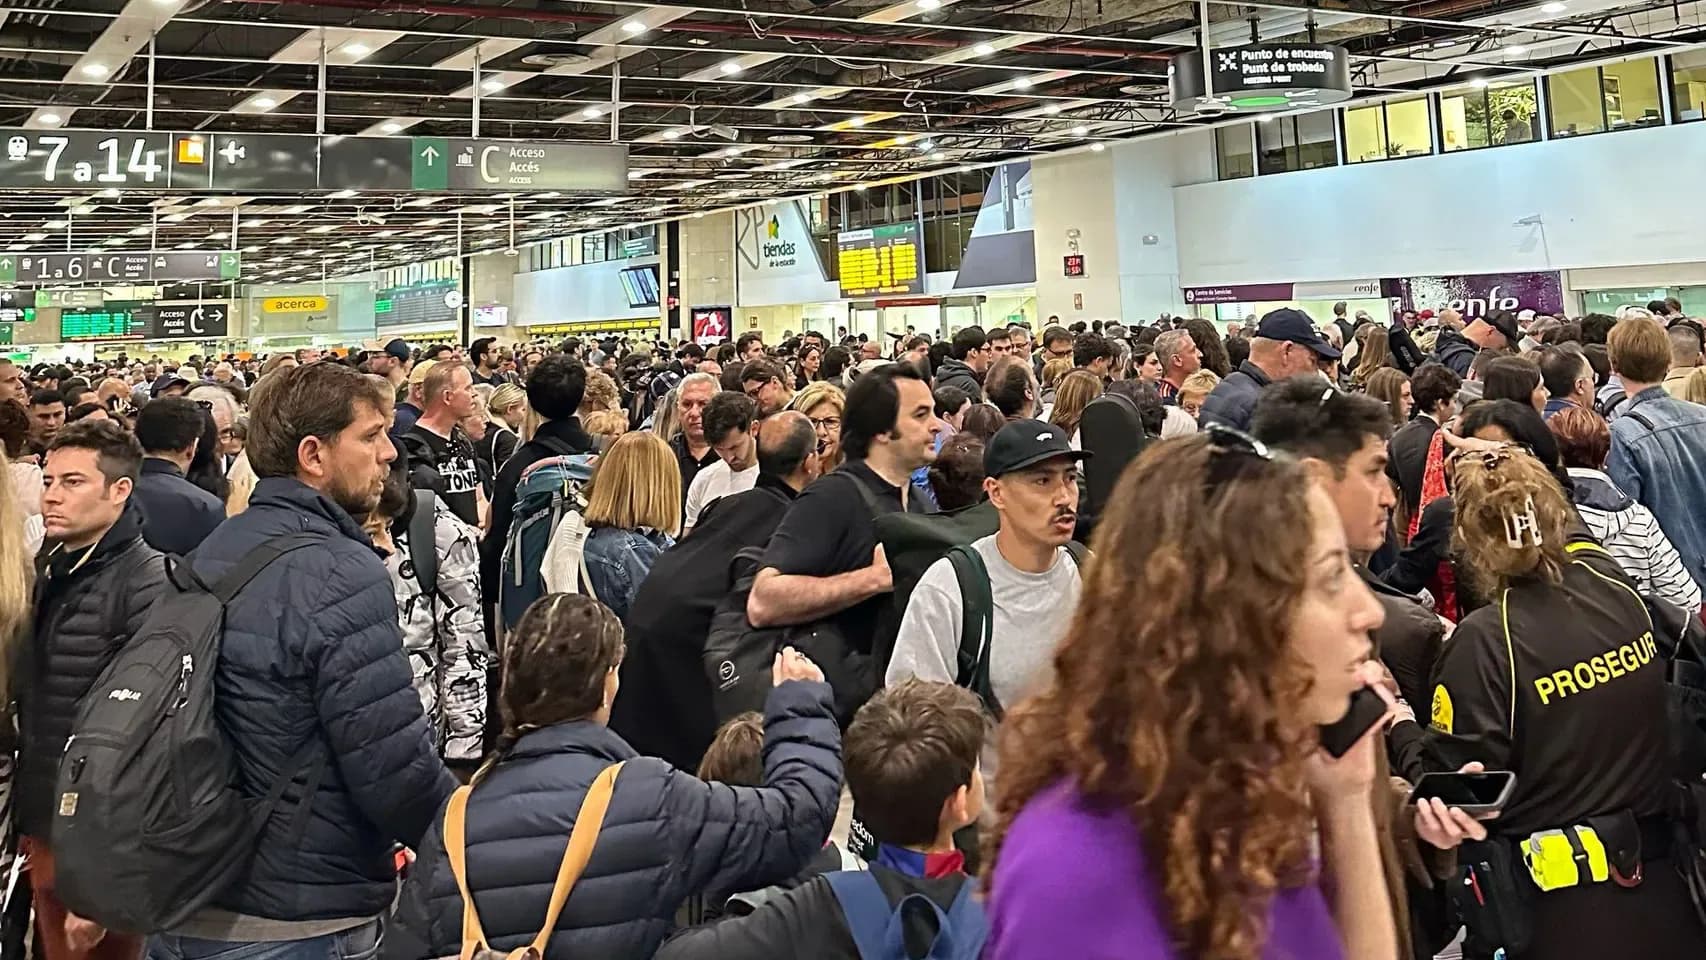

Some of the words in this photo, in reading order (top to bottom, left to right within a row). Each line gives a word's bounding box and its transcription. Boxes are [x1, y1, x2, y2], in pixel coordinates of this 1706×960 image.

[1241, 50, 1273, 61] Punto
[1275, 48, 1289, 59] de
[1291, 49, 1334, 61] encuentro
[1242, 64, 1269, 74] Punt
[1270, 62, 1284, 73] de
[1287, 61, 1325, 73] trobada
[38, 136, 69, 182] 7
[73, 161, 92, 182] a
[97, 138, 162, 182] 14
[509, 147, 545, 158] Acceso
[480, 145, 500, 183] C
[509, 161, 540, 173] Accés
[763, 240, 796, 257] tiendas
[37, 257, 51, 278] 1
[54, 268, 63, 278] a
[67, 257, 82, 278] 6
[107, 257, 120, 277] C
[1353, 282, 1379, 294] renfe
[275, 300, 316, 309] acerca
[1449, 286, 1519, 317] enfe
[163, 319, 185, 327] Accés
[190, 308, 204, 333] C
[1534, 631, 1657, 704] PROSEGUR
